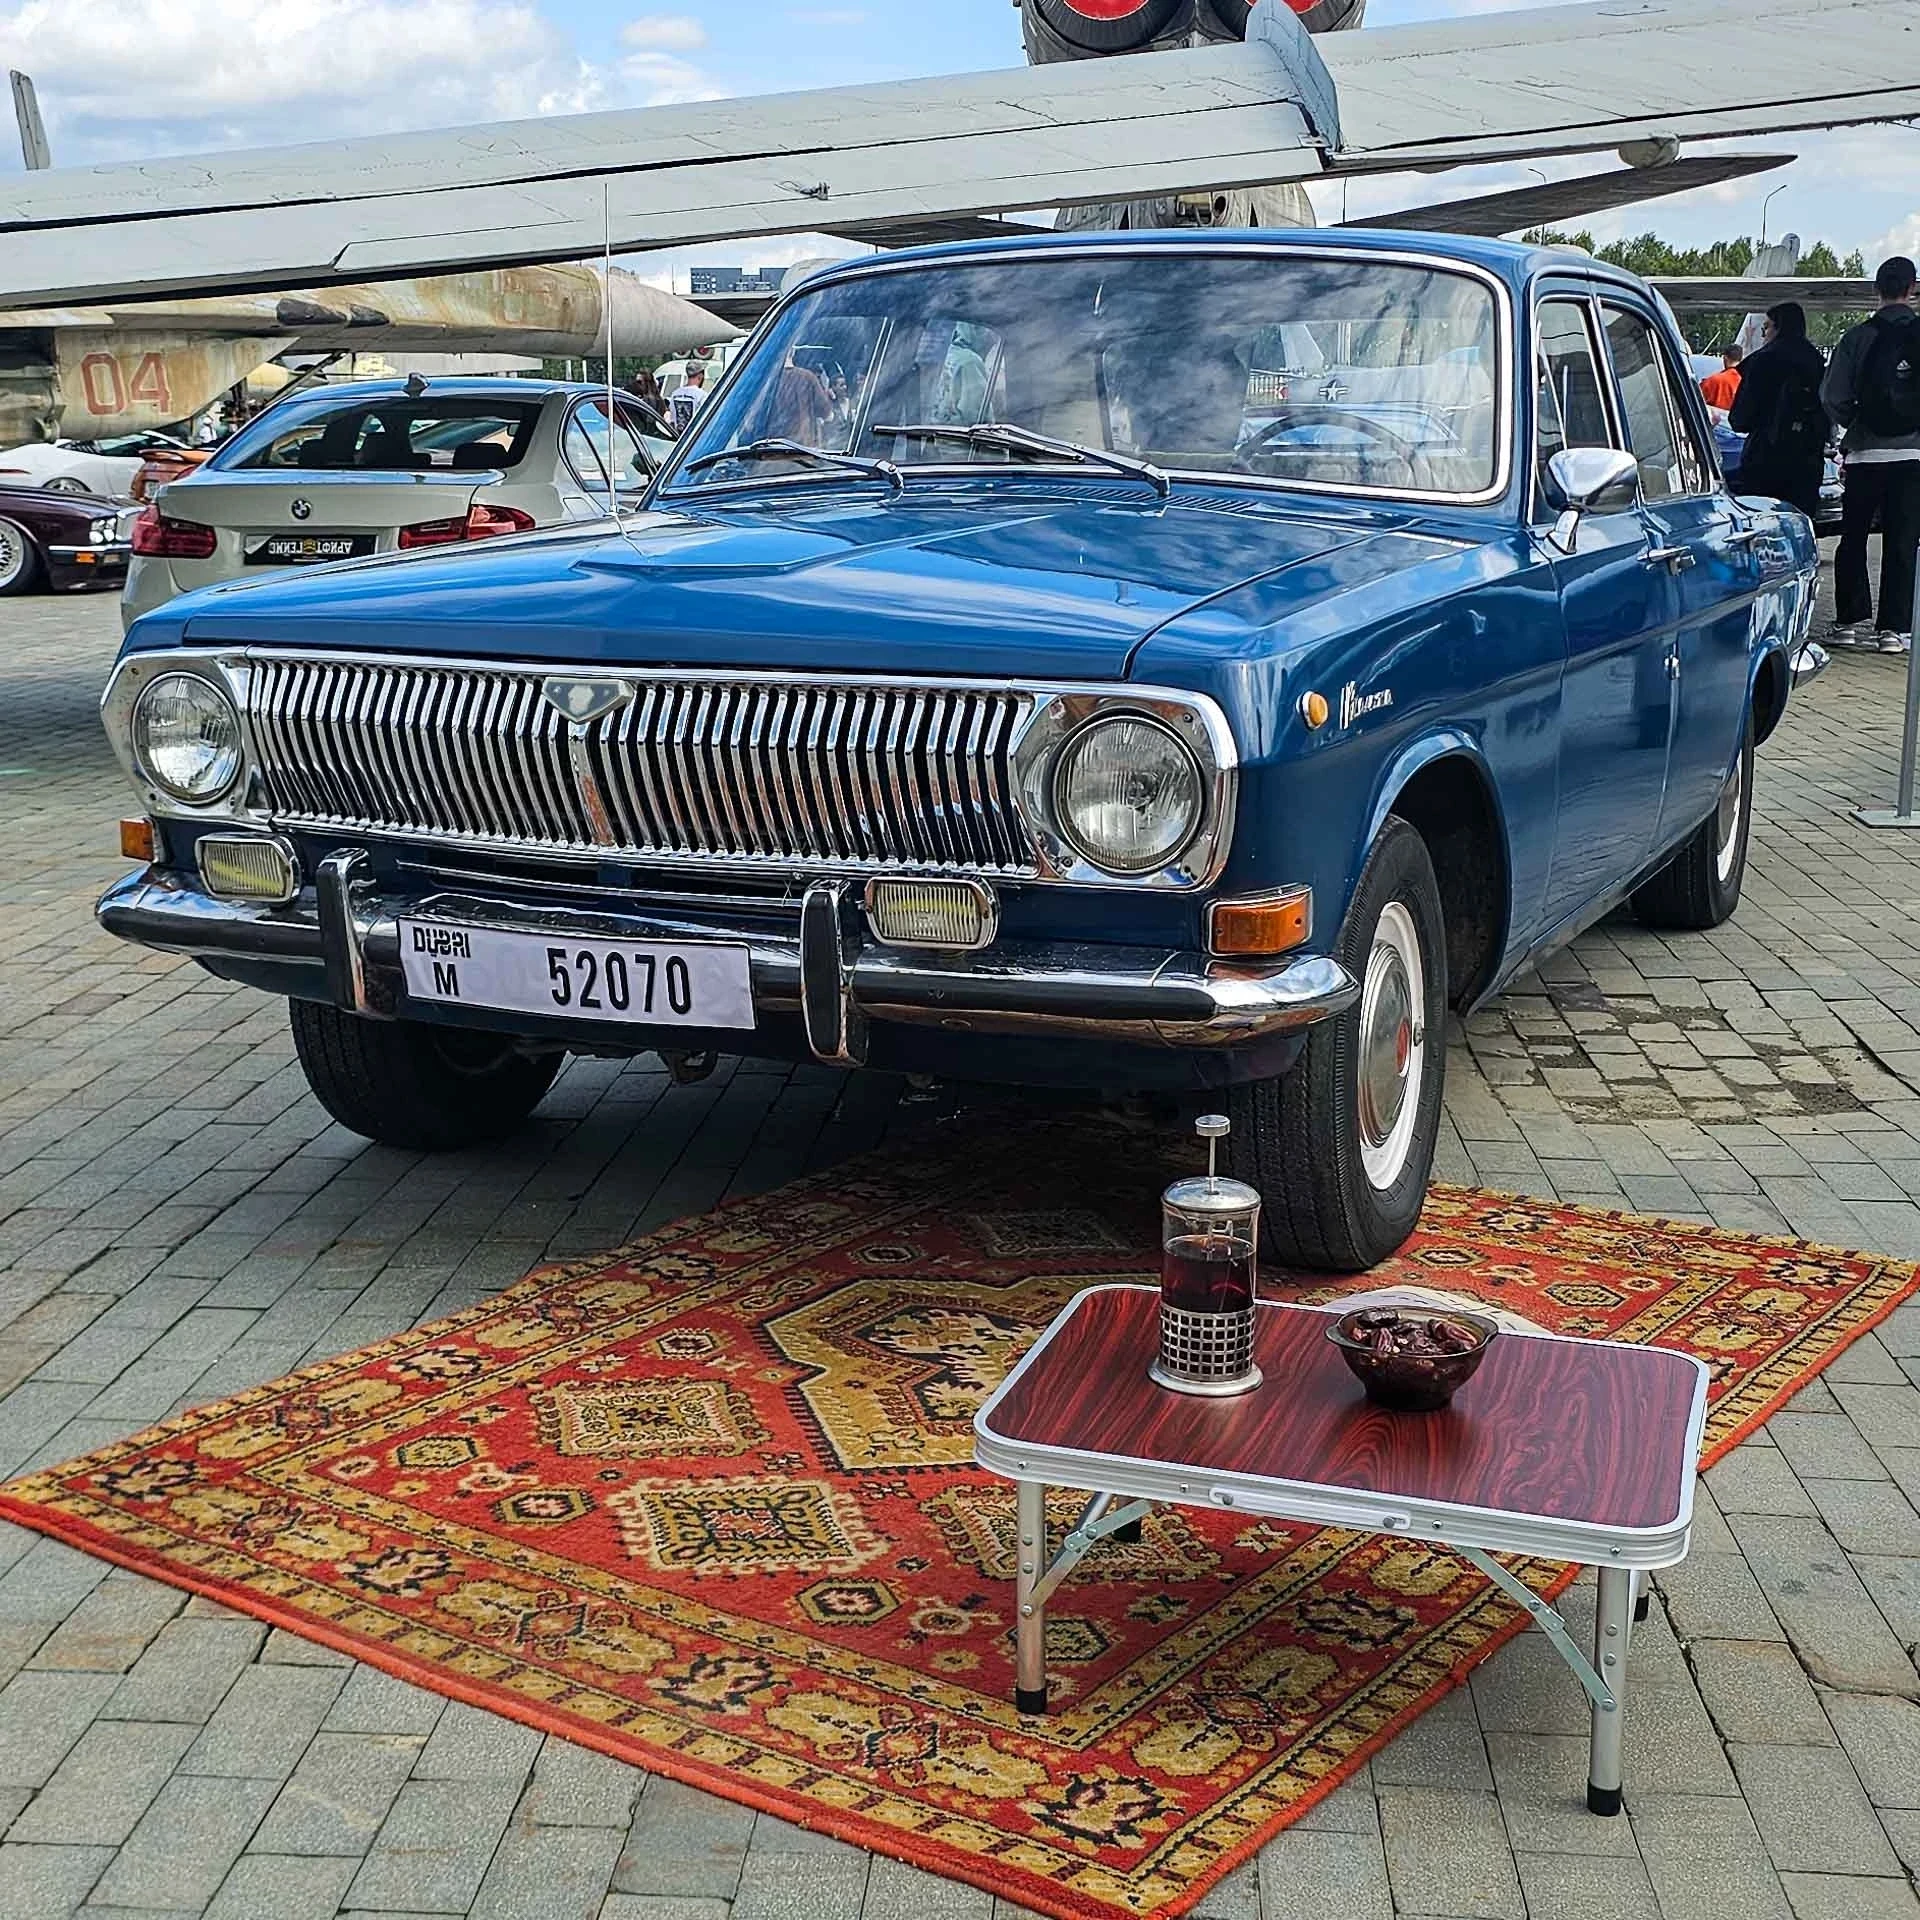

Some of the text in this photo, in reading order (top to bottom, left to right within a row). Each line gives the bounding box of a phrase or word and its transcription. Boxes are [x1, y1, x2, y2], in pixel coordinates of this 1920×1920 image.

[80, 351, 171, 416] 04
[316, 541, 353, 554] ДРИФТ
[413, 926, 471, 958] DUBAI
[433, 961, 459, 997] M
[546, 947, 692, 1015] 52070
